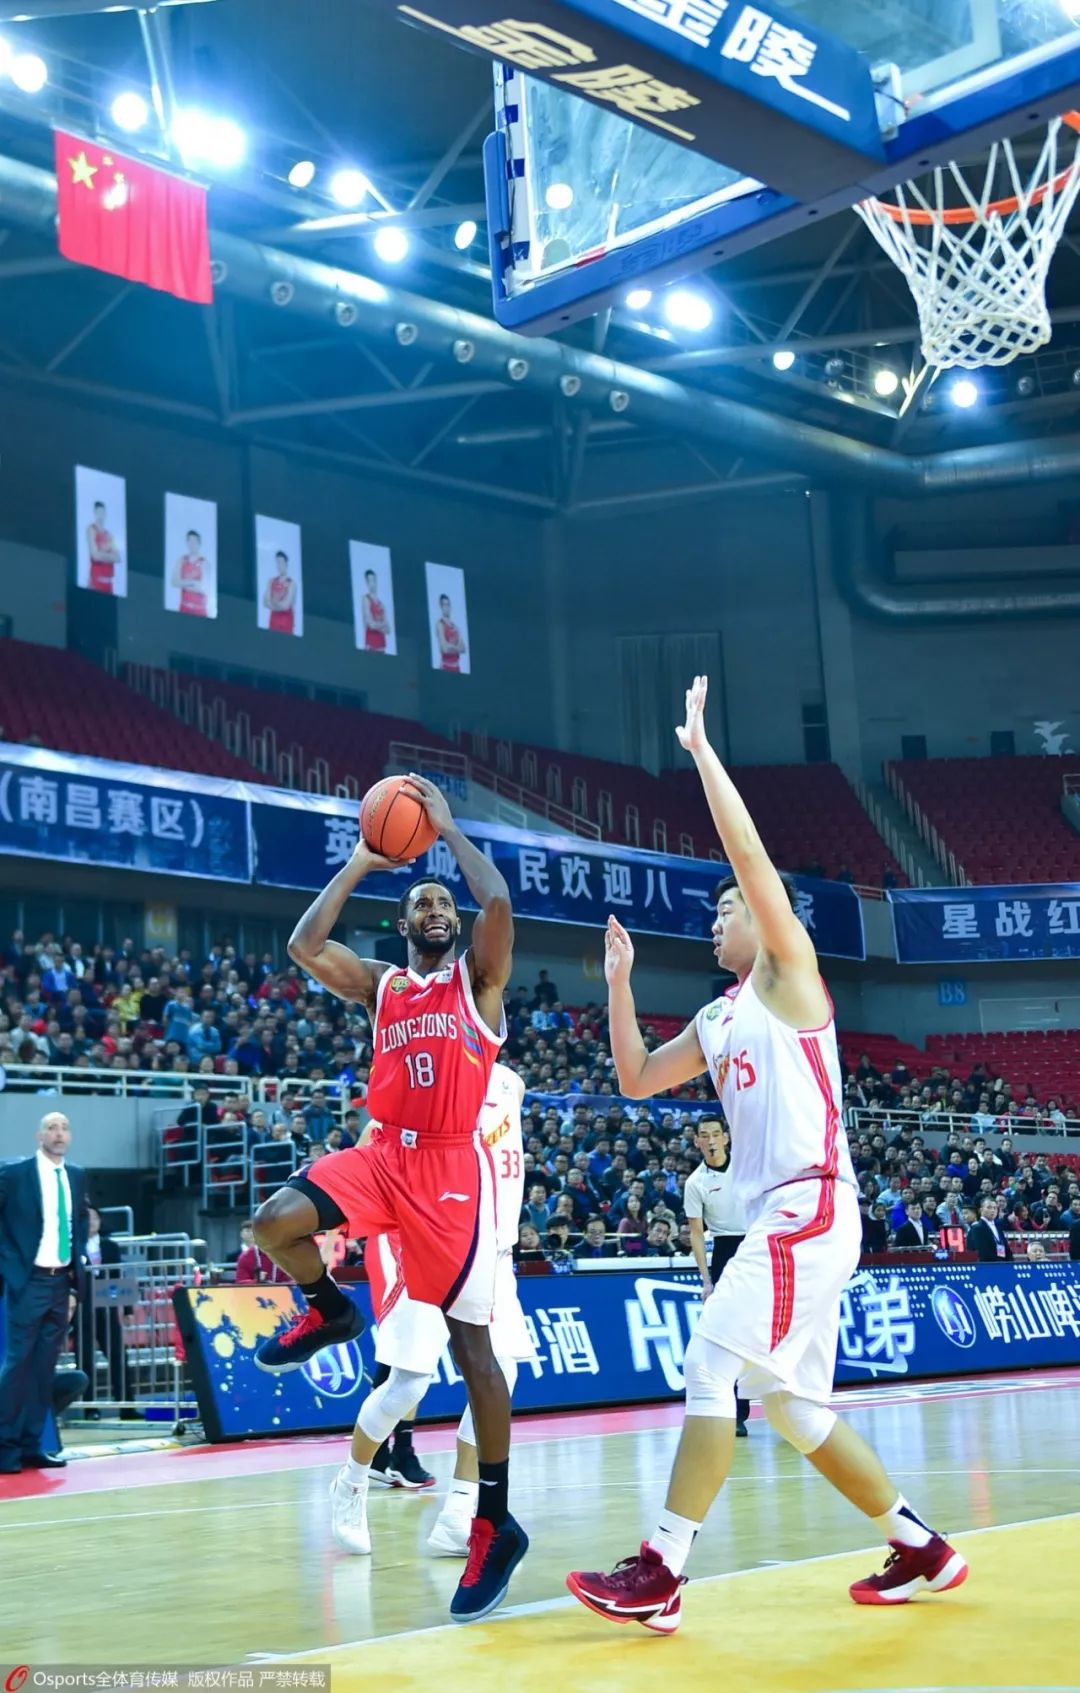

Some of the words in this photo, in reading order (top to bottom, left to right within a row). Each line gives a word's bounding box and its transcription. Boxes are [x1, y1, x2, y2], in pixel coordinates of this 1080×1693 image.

[397, 4, 701, 141] 金陵
[942, 899, 1080, 939] 星战红
[405, 1051, 436, 1089] 18
[732, 1049, 757, 1092] 15
[501, 1149, 520, 1179] 33
[973, 1281, 1080, 1344] 崂山啤
